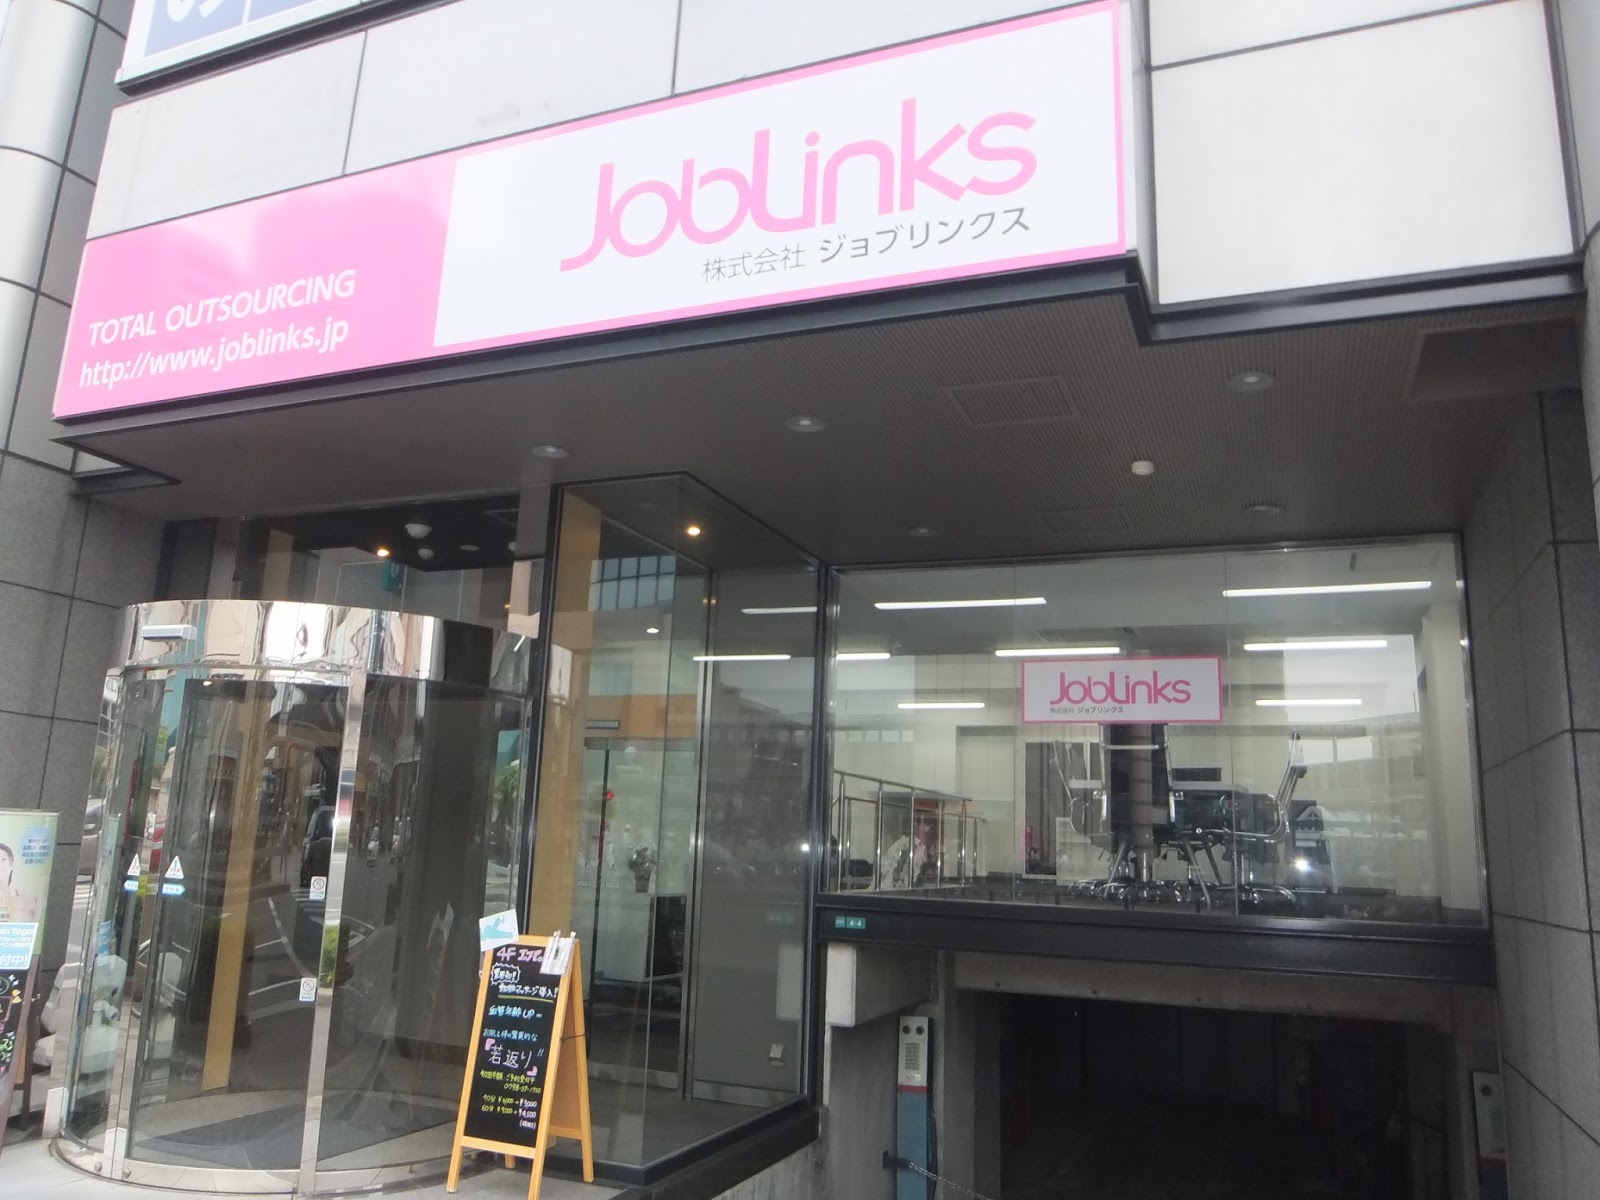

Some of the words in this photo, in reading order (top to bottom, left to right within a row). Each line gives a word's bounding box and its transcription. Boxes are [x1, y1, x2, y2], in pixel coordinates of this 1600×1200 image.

[702, 243, 806, 284] 株式会社
[819, 206, 1030, 264] ジョブリンクス
[89, 311, 157, 347] TOTAL
[165, 269, 356, 332] OUTSOURCING
[79, 316, 349, 390] http://www.joblinks.jp
[1077, 706, 1124, 714] ジョブリンクス
[496, 946, 517, 961] 4F
